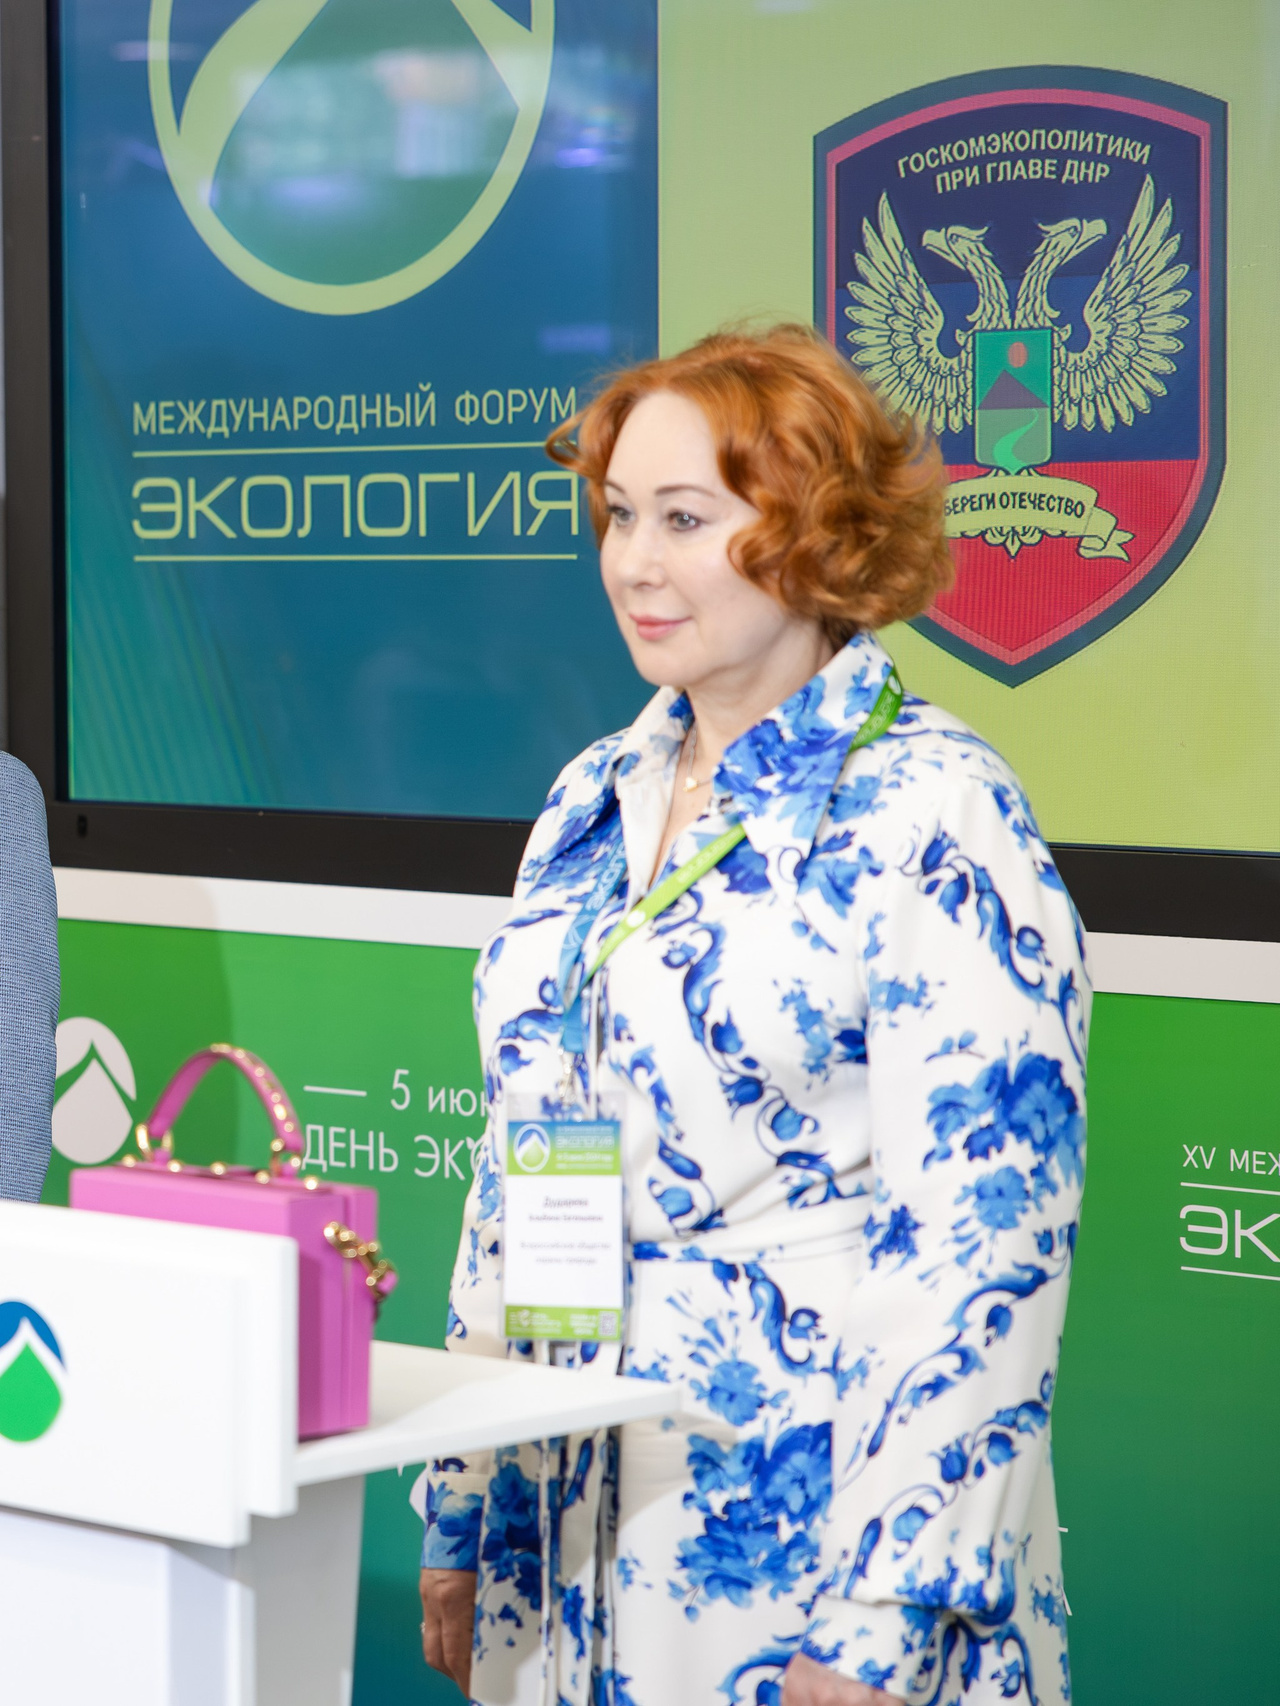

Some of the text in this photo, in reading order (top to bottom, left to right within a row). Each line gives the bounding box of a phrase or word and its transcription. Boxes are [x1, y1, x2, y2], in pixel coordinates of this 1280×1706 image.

[898, 129, 1151, 178] ГОСКОМЭКОПОЛИТИКИ
[935, 159, 1110, 194] ПРИ ГЛАВЕ ДНР
[133, 382, 577, 439] МЕЖДУНАРОДНЫЙ ФОРУМ
[132, 471, 579, 539] ЭКОЛОГИЯ
[999, 491, 1085, 518] ОТЕЧЕСТВО
[391, 1068, 411, 1110] 5
[301, 1123, 399, 1173] ДЕНЬ
[1182, 1144, 1216, 1169] XV
